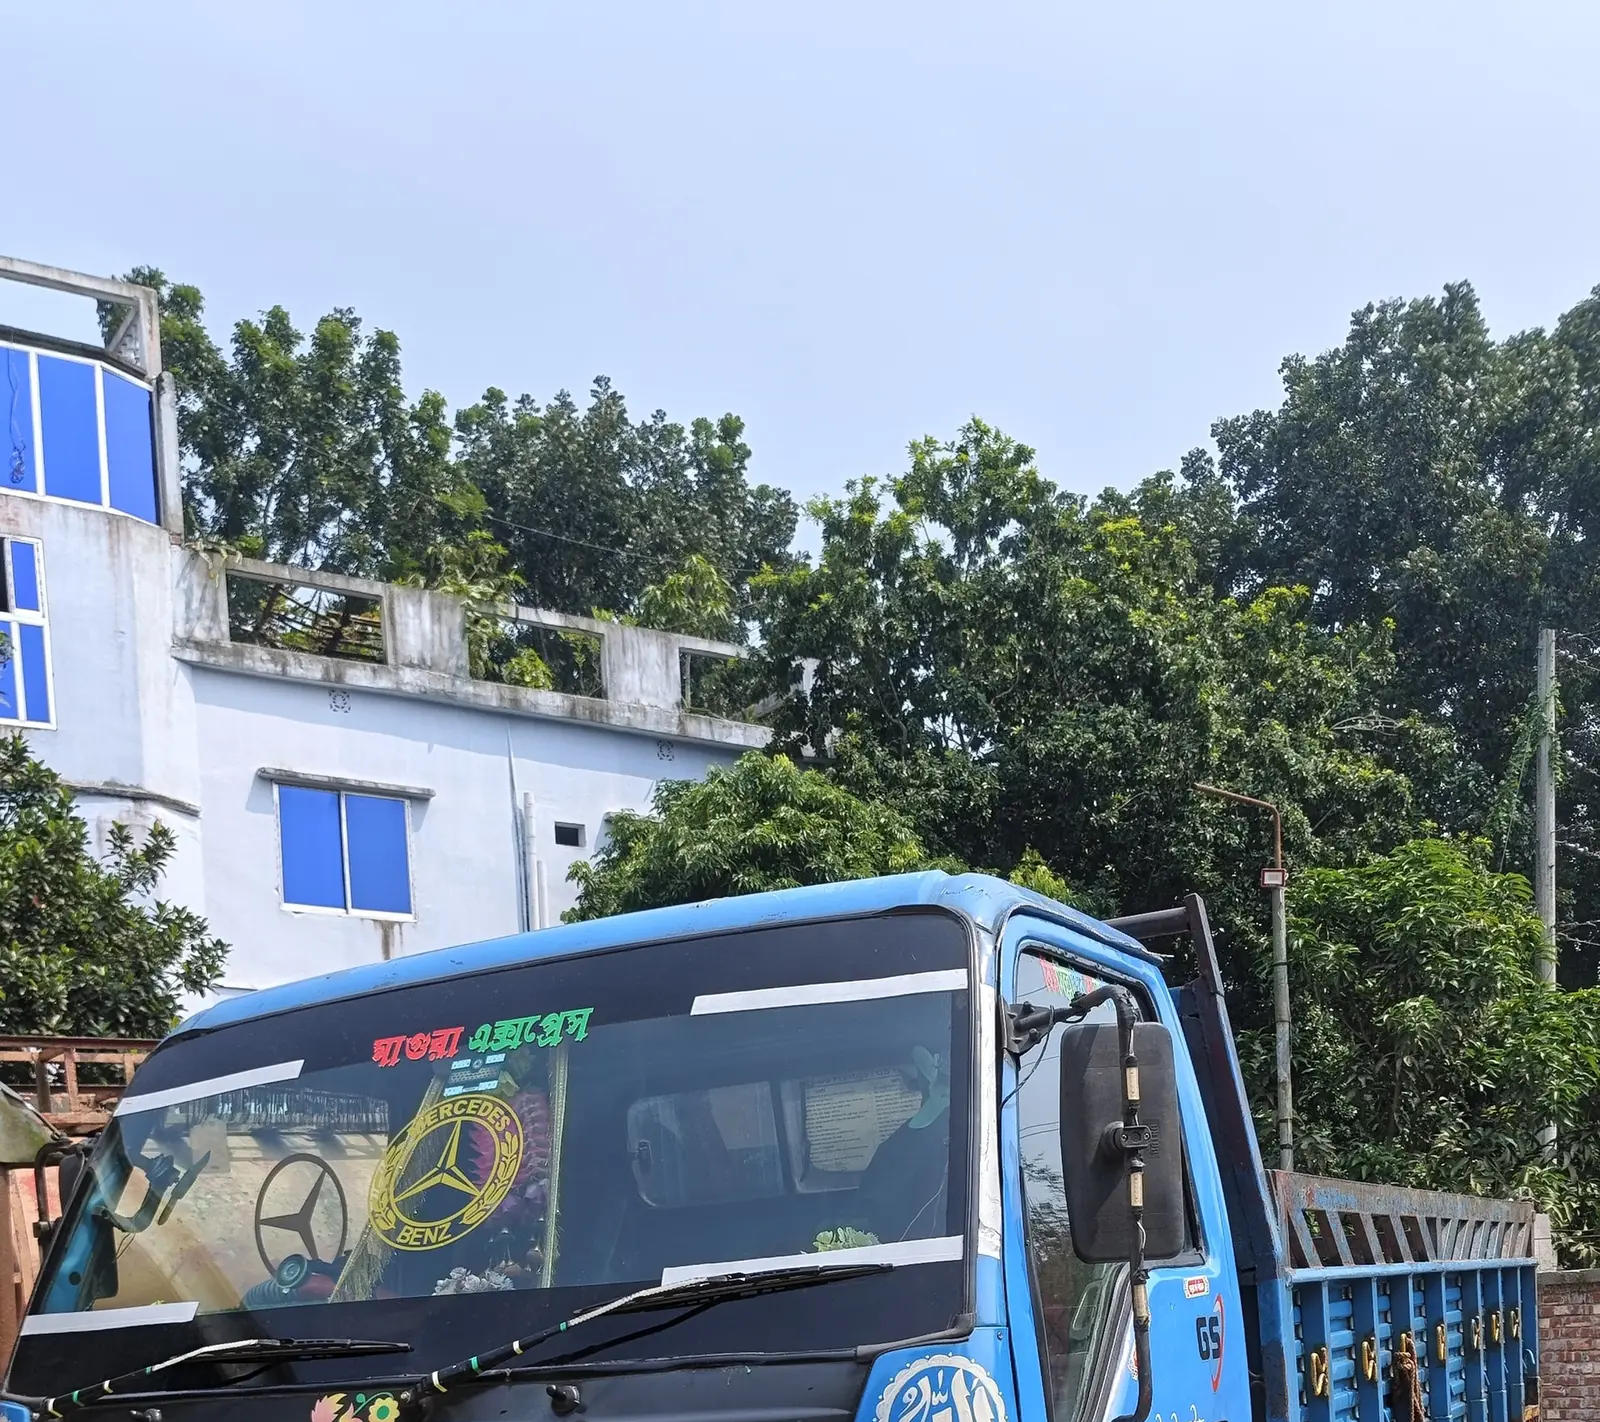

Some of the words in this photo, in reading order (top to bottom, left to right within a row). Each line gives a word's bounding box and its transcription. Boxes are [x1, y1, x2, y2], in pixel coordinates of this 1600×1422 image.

[371, 1026, 465, 1068] মাগুরা
[408, 1100, 511, 1140] MERCEDES
[396, 1221, 452, 1246] BENZ
[1195, 1316, 1221, 1361] GS
